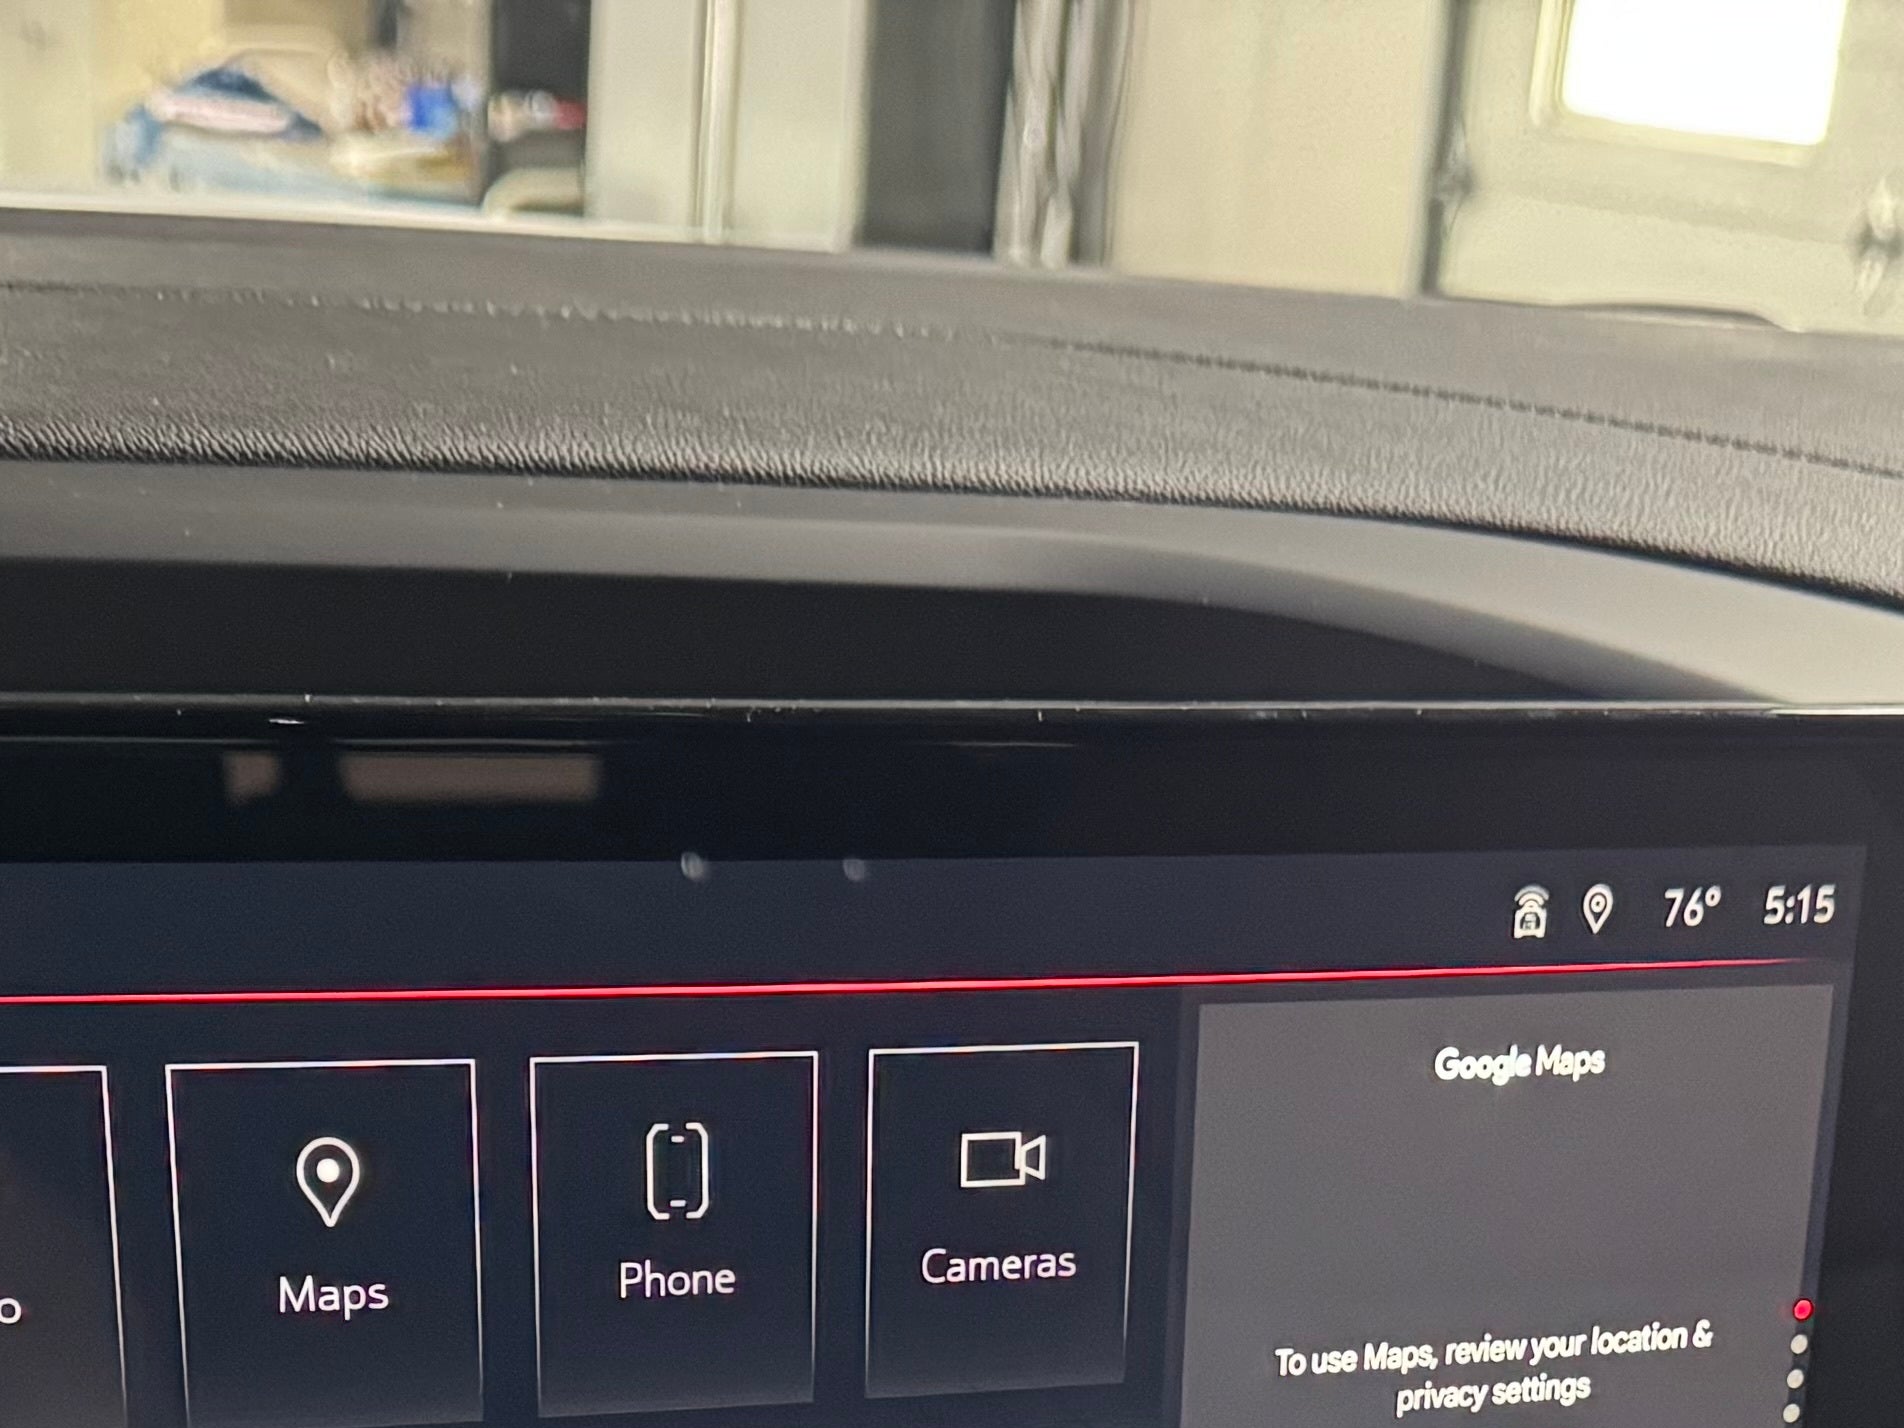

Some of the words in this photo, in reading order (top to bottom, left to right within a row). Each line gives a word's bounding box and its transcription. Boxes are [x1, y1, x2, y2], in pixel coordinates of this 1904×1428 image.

[1665, 885, 1722, 927] 76°
[1764, 884, 1835, 925] 5:15
[1434, 1044, 1532, 1086] Google
[1534, 1043, 1606, 1082] Maps
[620, 1259, 736, 1299] Phone
[922, 1247, 1077, 1284] Cameras
[279, 1274, 389, 1321] Maps
[1275, 1348, 1307, 1377] To
[1311, 1351, 1357, 1375] use
[1363, 1341, 1439, 1374] Maps,
[1445, 1333, 1527, 1366] review
[1528, 1330, 1588, 1366] your
[1591, 1322, 1688, 1355] location
[1692, 1319, 1713, 1349] &
[1396, 1381, 1489, 1417] privacy
[1491, 1373, 1591, 1407] settings
